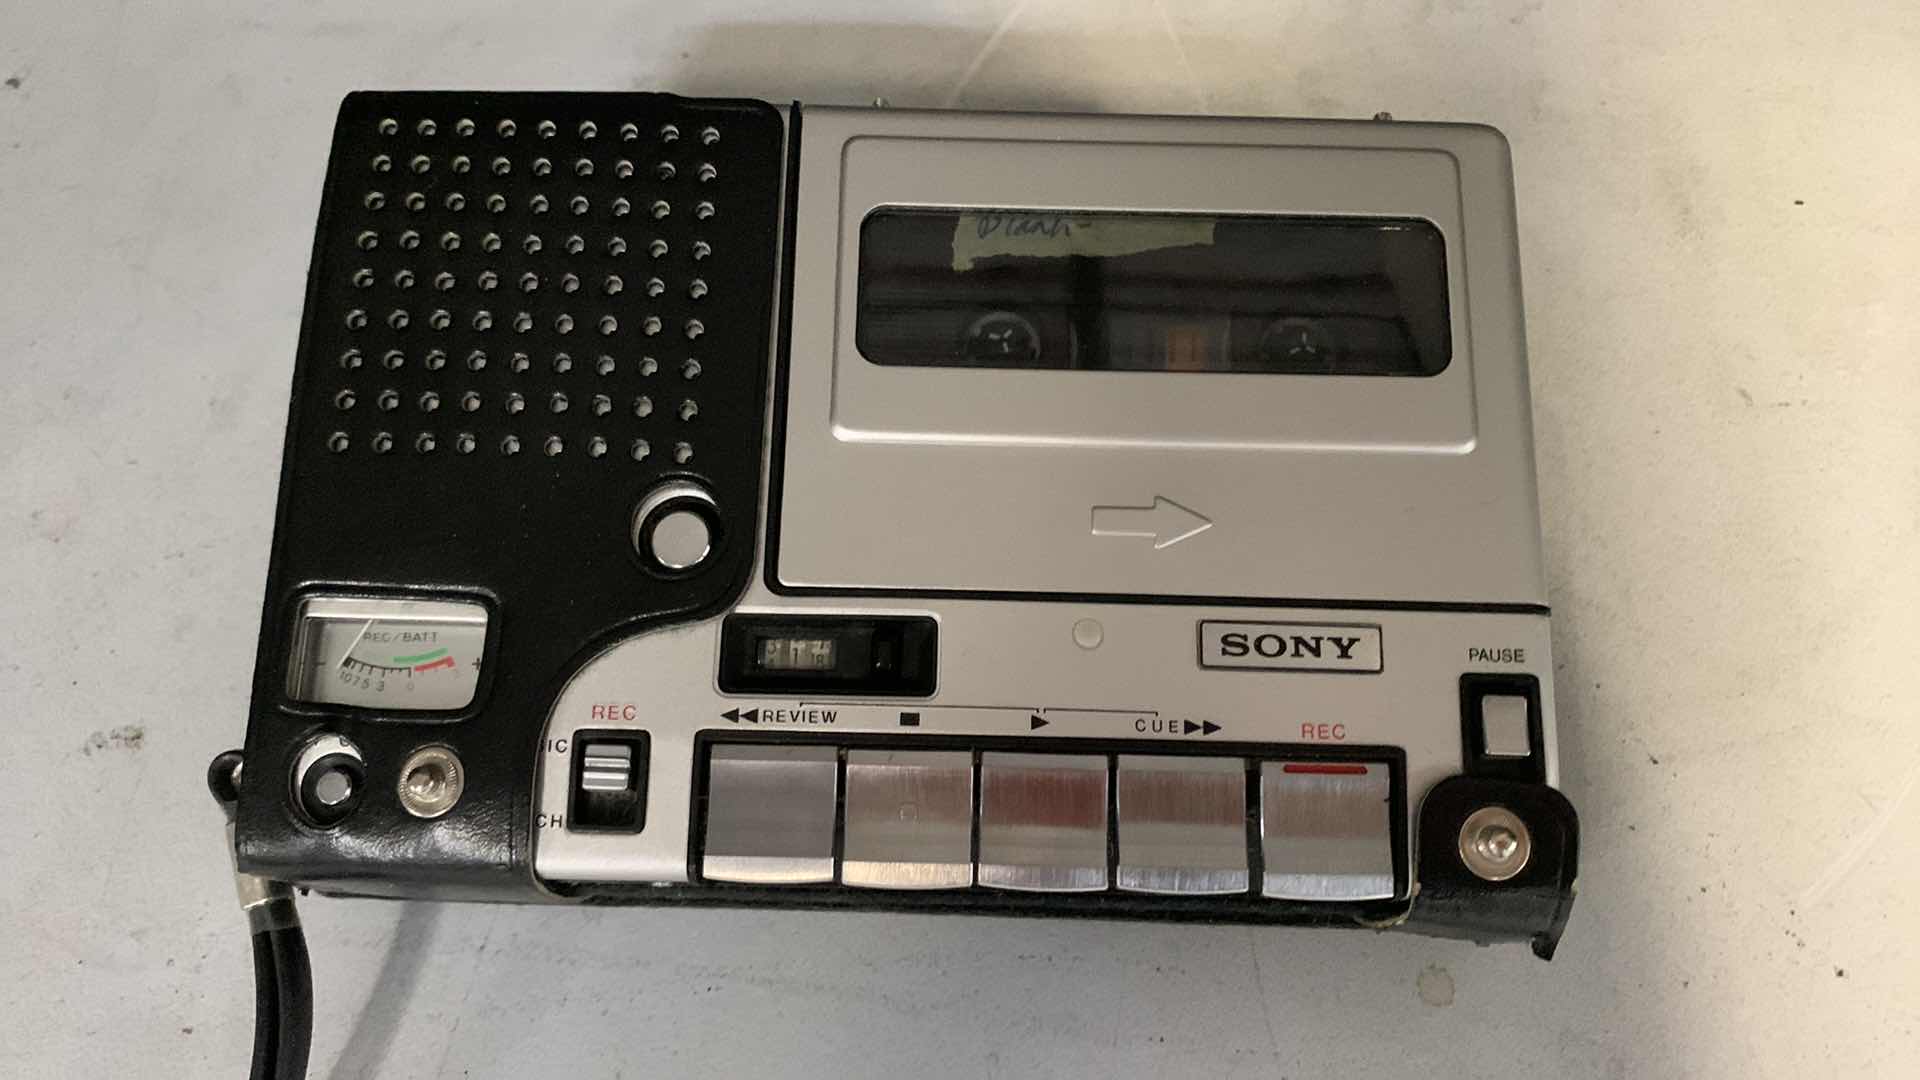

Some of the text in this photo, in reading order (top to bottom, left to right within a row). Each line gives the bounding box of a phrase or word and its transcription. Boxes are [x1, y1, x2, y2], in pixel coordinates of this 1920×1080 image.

[1220, 633, 1361, 659] SONY
[1468, 647, 1525, 664] PAUSE
[591, 704, 637, 721] REC
[762, 709, 838, 724] REVIEW
[1135, 719, 1179, 733] CUE
[1301, 723, 1346, 740] REC
